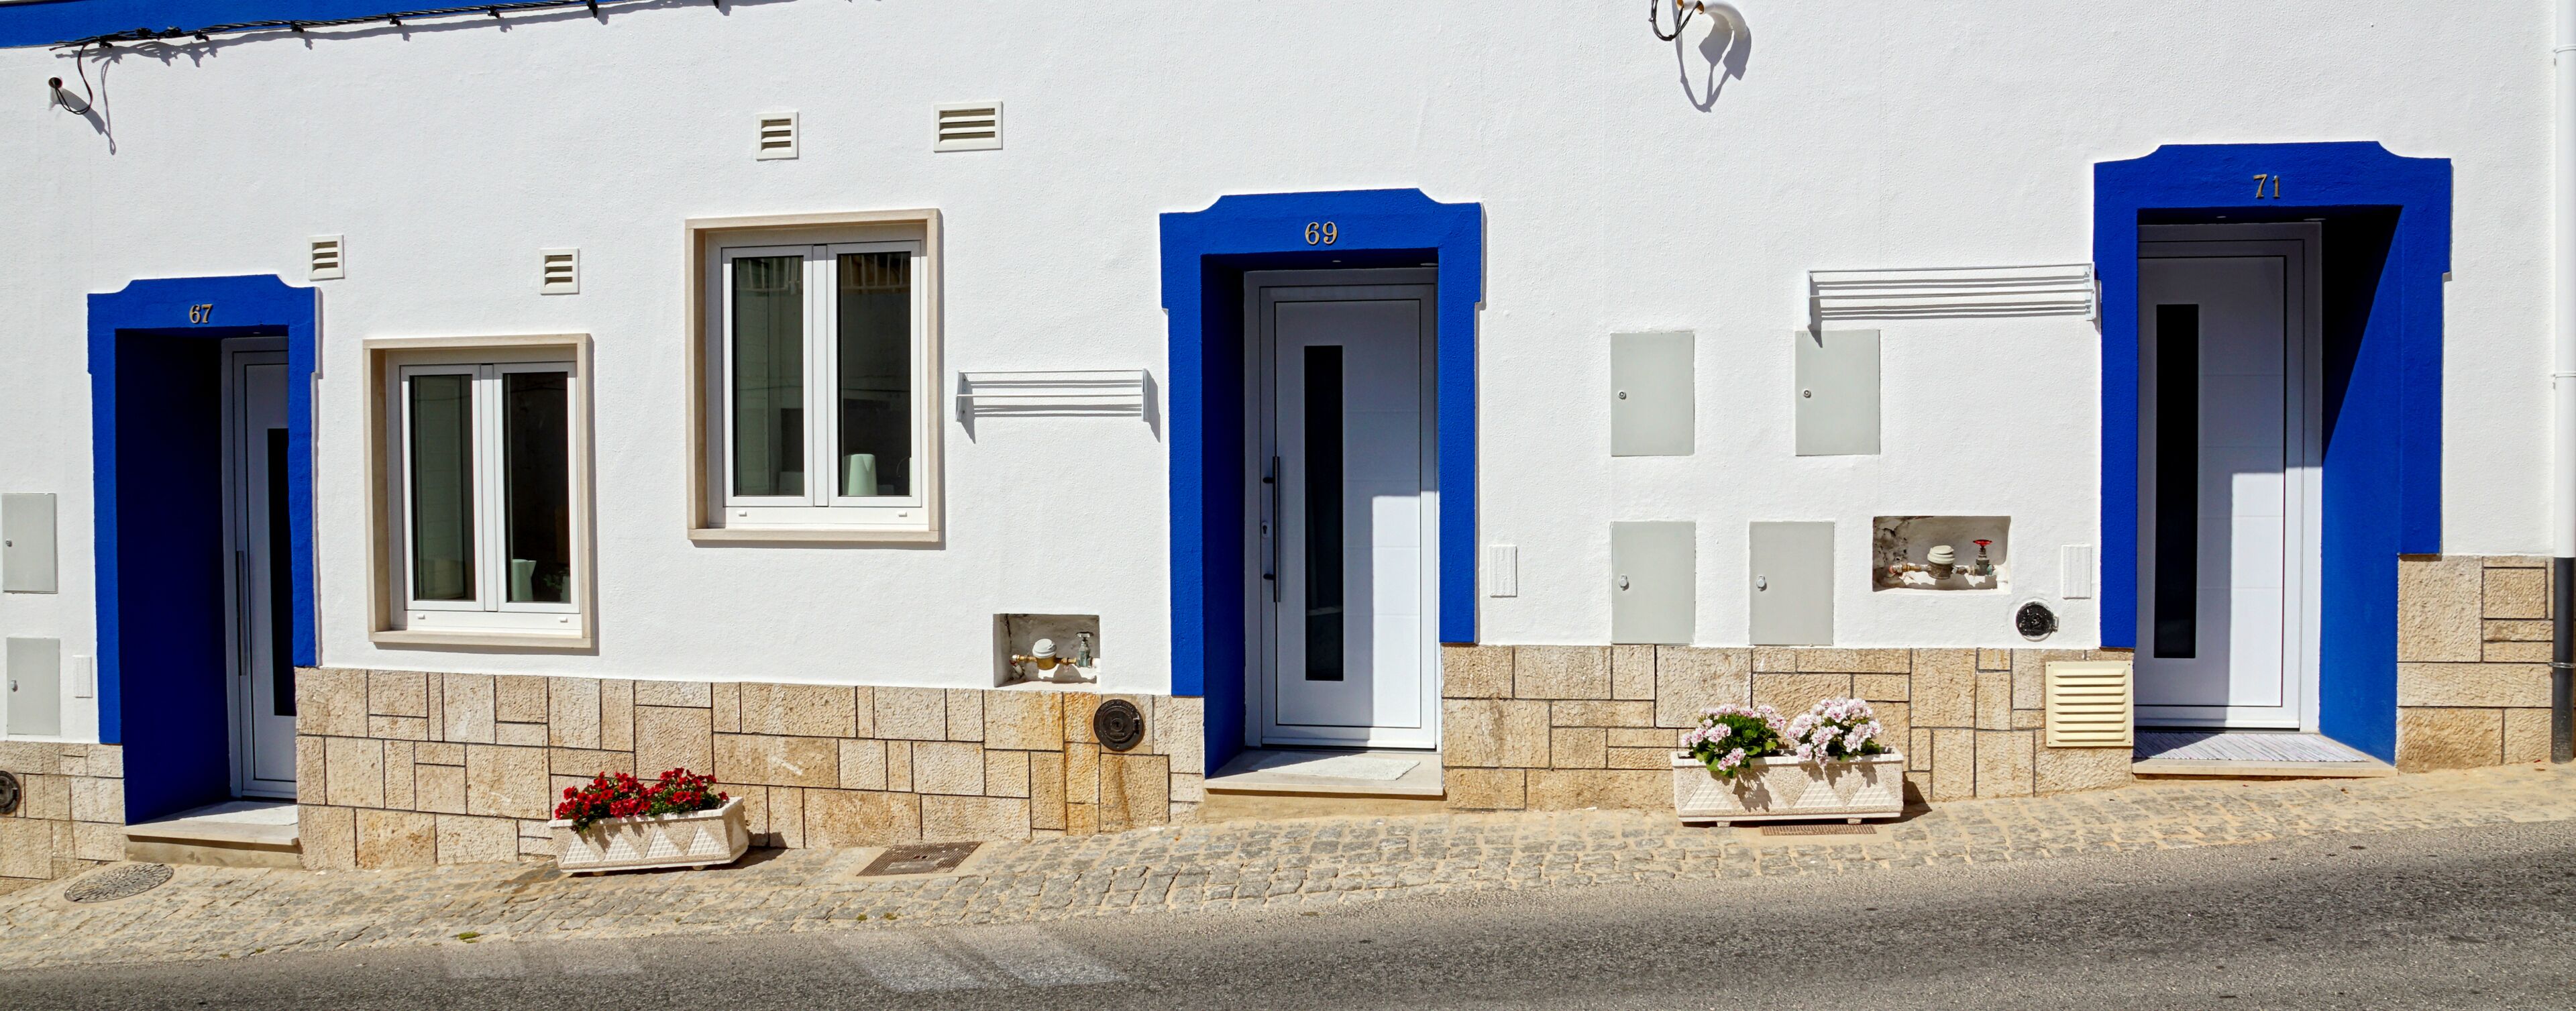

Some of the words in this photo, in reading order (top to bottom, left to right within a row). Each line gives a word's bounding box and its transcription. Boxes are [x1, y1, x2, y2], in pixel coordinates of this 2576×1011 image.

[2253, 174, 2280, 198] 71
[1305, 221, 1338, 245] 69
[189, 304, 213, 323] 67
